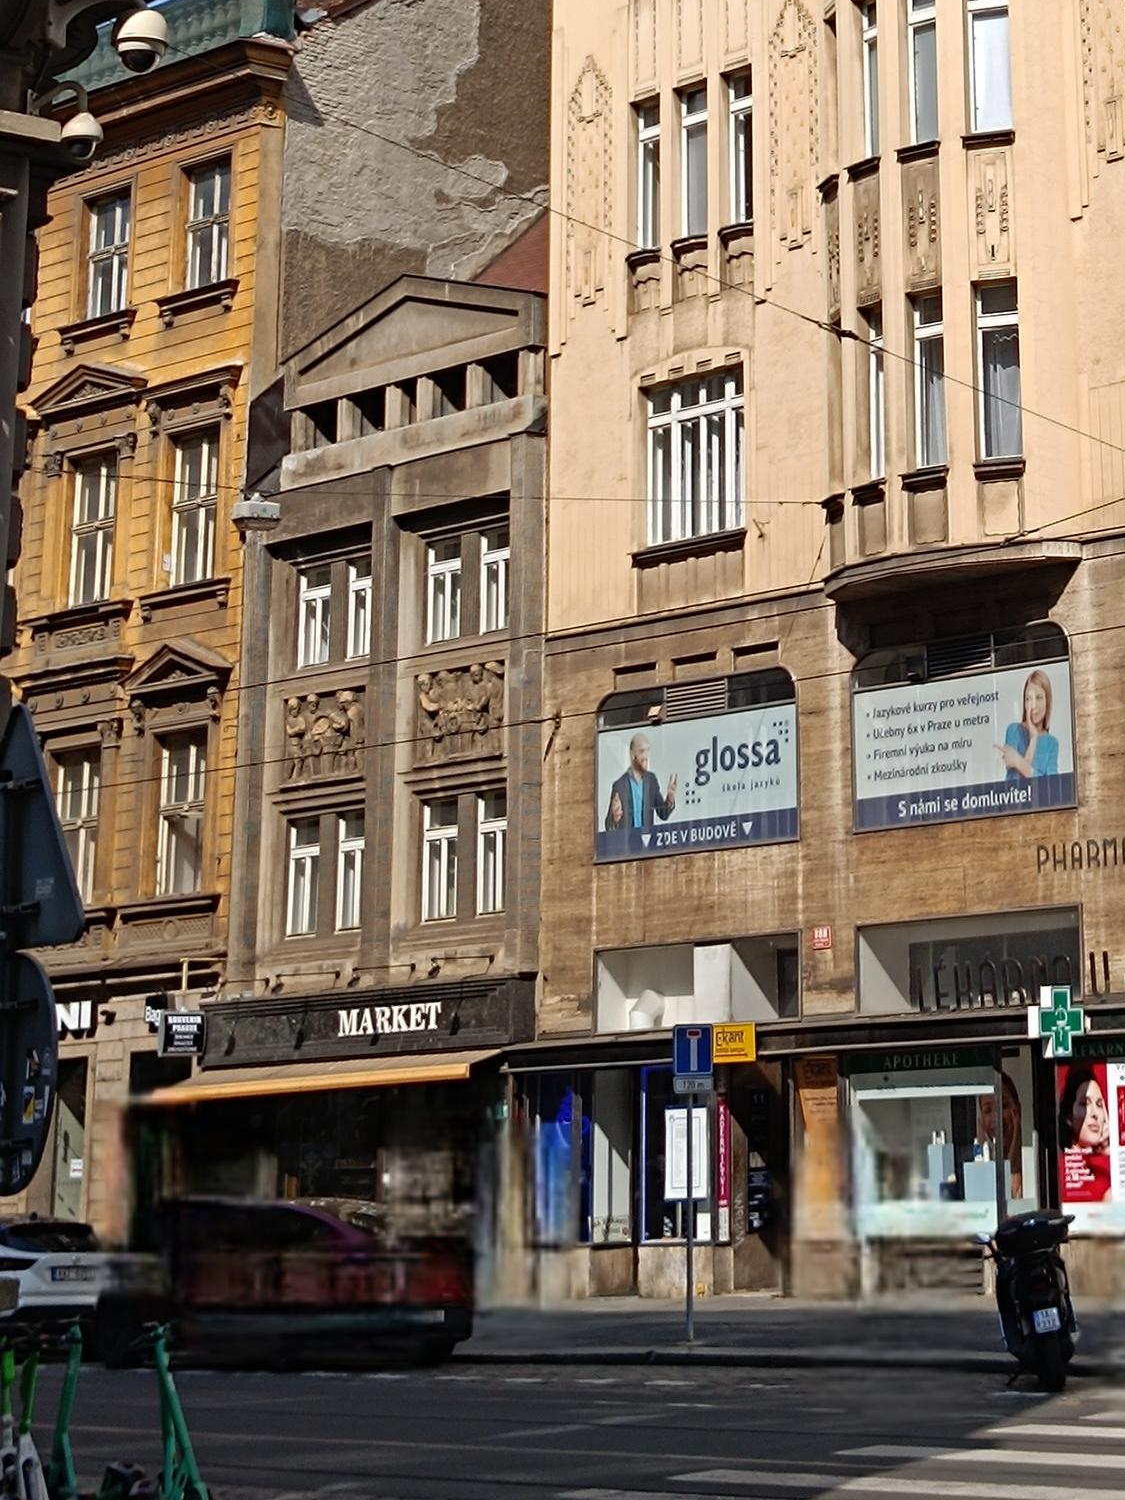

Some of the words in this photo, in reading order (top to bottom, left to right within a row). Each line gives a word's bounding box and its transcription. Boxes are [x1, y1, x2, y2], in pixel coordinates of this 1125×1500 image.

[872, 705, 912, 720] Jazykové
[913, 701, 938, 715] kurzy
[939, 698, 955, 711] pro
[956, 691, 999, 708] veřejnost
[873, 724, 905, 740] Učebny
[907, 723, 919, 735] 6x
[920, 724, 927, 733] v
[927, 720, 952, 732] Praze
[954, 718, 961, 728] u
[962, 714, 990, 726] metra
[694, 735, 782, 786] glossa
[873, 745, 907, 760] Firemní
[908, 742, 936, 758] výuka
[937, 742, 949, 751] na
[951, 737, 973, 749] míru
[873, 765, 929, 781] Mezinárodní
[930, 760, 968, 774] zkoušky
[898, 800, 907, 817] S
[909, 796, 941, 816] námi
[944, 797, 959, 811] se
[961, 785, 1032, 810] domluvíte!
[656, 828, 678, 846] ZDE
[680, 828, 690, 844] V
[690, 821, 737, 842] BUDOVĚ
[337, 1001, 442, 1037] MARKET
[882, 1051, 959, 1069] APOTHEKE
